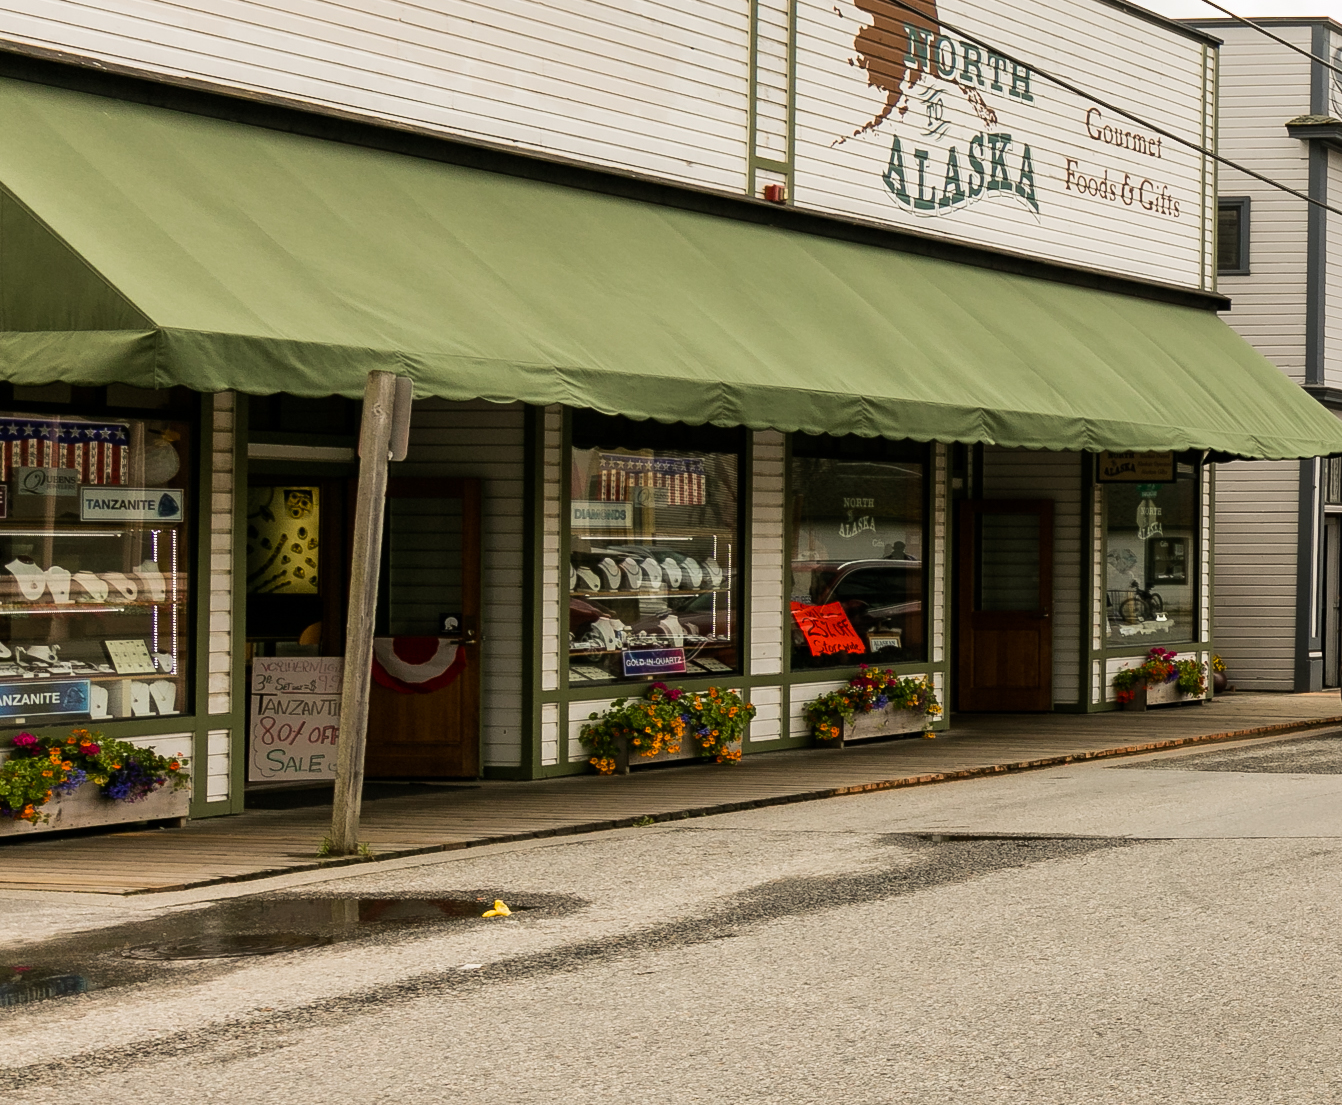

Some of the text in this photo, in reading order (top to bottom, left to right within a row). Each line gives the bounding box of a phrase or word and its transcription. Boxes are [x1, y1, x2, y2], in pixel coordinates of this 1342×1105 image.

[903, 22, 1034, 102] NORTH
[1086, 108, 1162, 158] Gourmet
[883, 131, 1040, 216] ALASKA
[1066, 158, 1180, 217] Foods & Gifts
[1104, 463, 1136, 476] ALASKA
[86, 498, 156, 510] TANZANITE
[843, 497, 875, 508] NORTH
[1140, 507, 1162, 516] NORTH
[574, 508, 627, 520] DIAMONDS
[839, 516, 876, 538] ALASKA
[626, 656, 682, 666] GOLD-IN-QUARTZ
[308, 725, 340, 745] OFF
[267, 749, 325, 772] SALE
